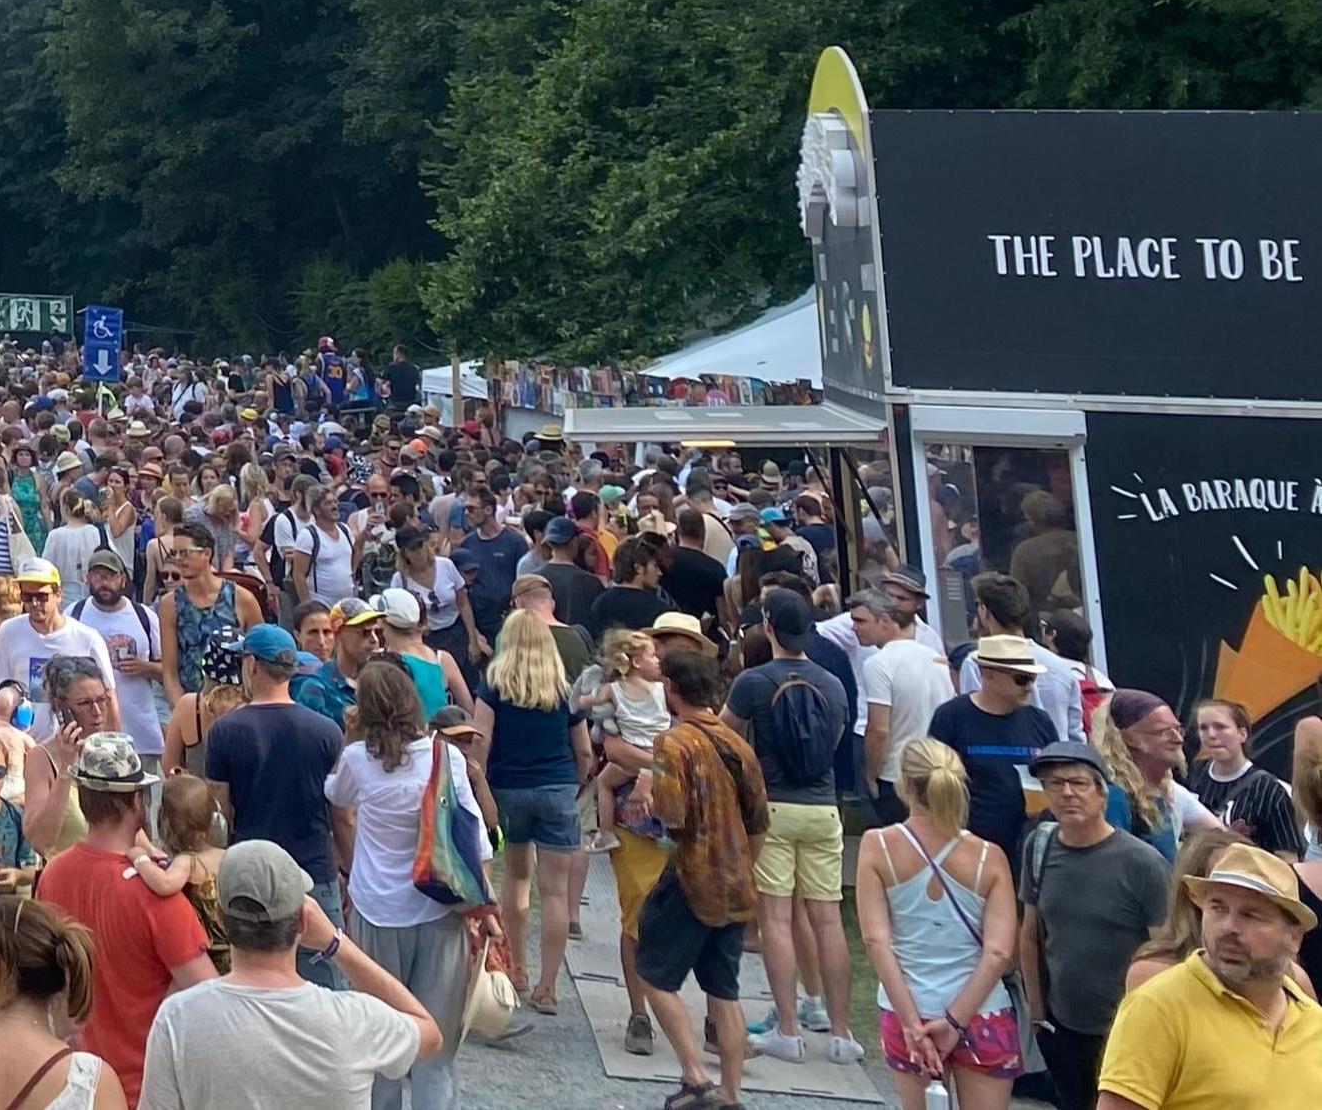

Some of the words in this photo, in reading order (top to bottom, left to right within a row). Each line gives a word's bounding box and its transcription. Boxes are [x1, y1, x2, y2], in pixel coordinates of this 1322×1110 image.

[987, 234, 1058, 277] THE
[1071, 236, 1182, 279] PLACE
[1195, 238, 1245, 280] TO
[1259, 239, 1304, 282] BE
[1139, 487, 1180, 522] LA
[1181, 478, 1300, 513] BARAQUE
